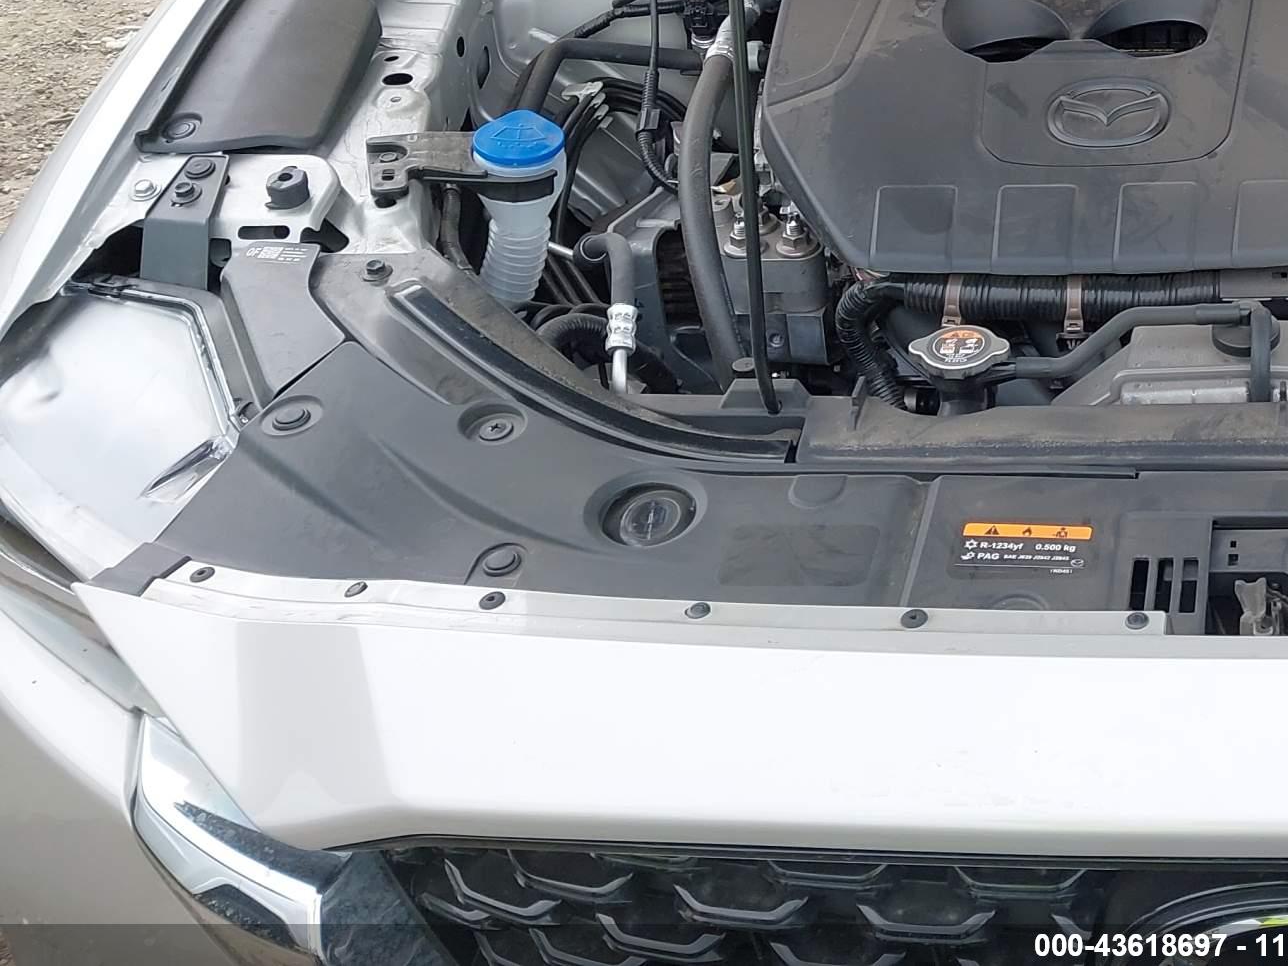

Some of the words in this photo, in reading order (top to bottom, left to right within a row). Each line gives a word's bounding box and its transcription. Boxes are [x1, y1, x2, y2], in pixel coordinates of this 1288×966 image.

[979, 541, 1024, 550] R-1234yf
[1035, 543, 1062, 551] 0.500
[1063, 544, 1076, 553] kg
[977, 552, 1000, 560] PAG
